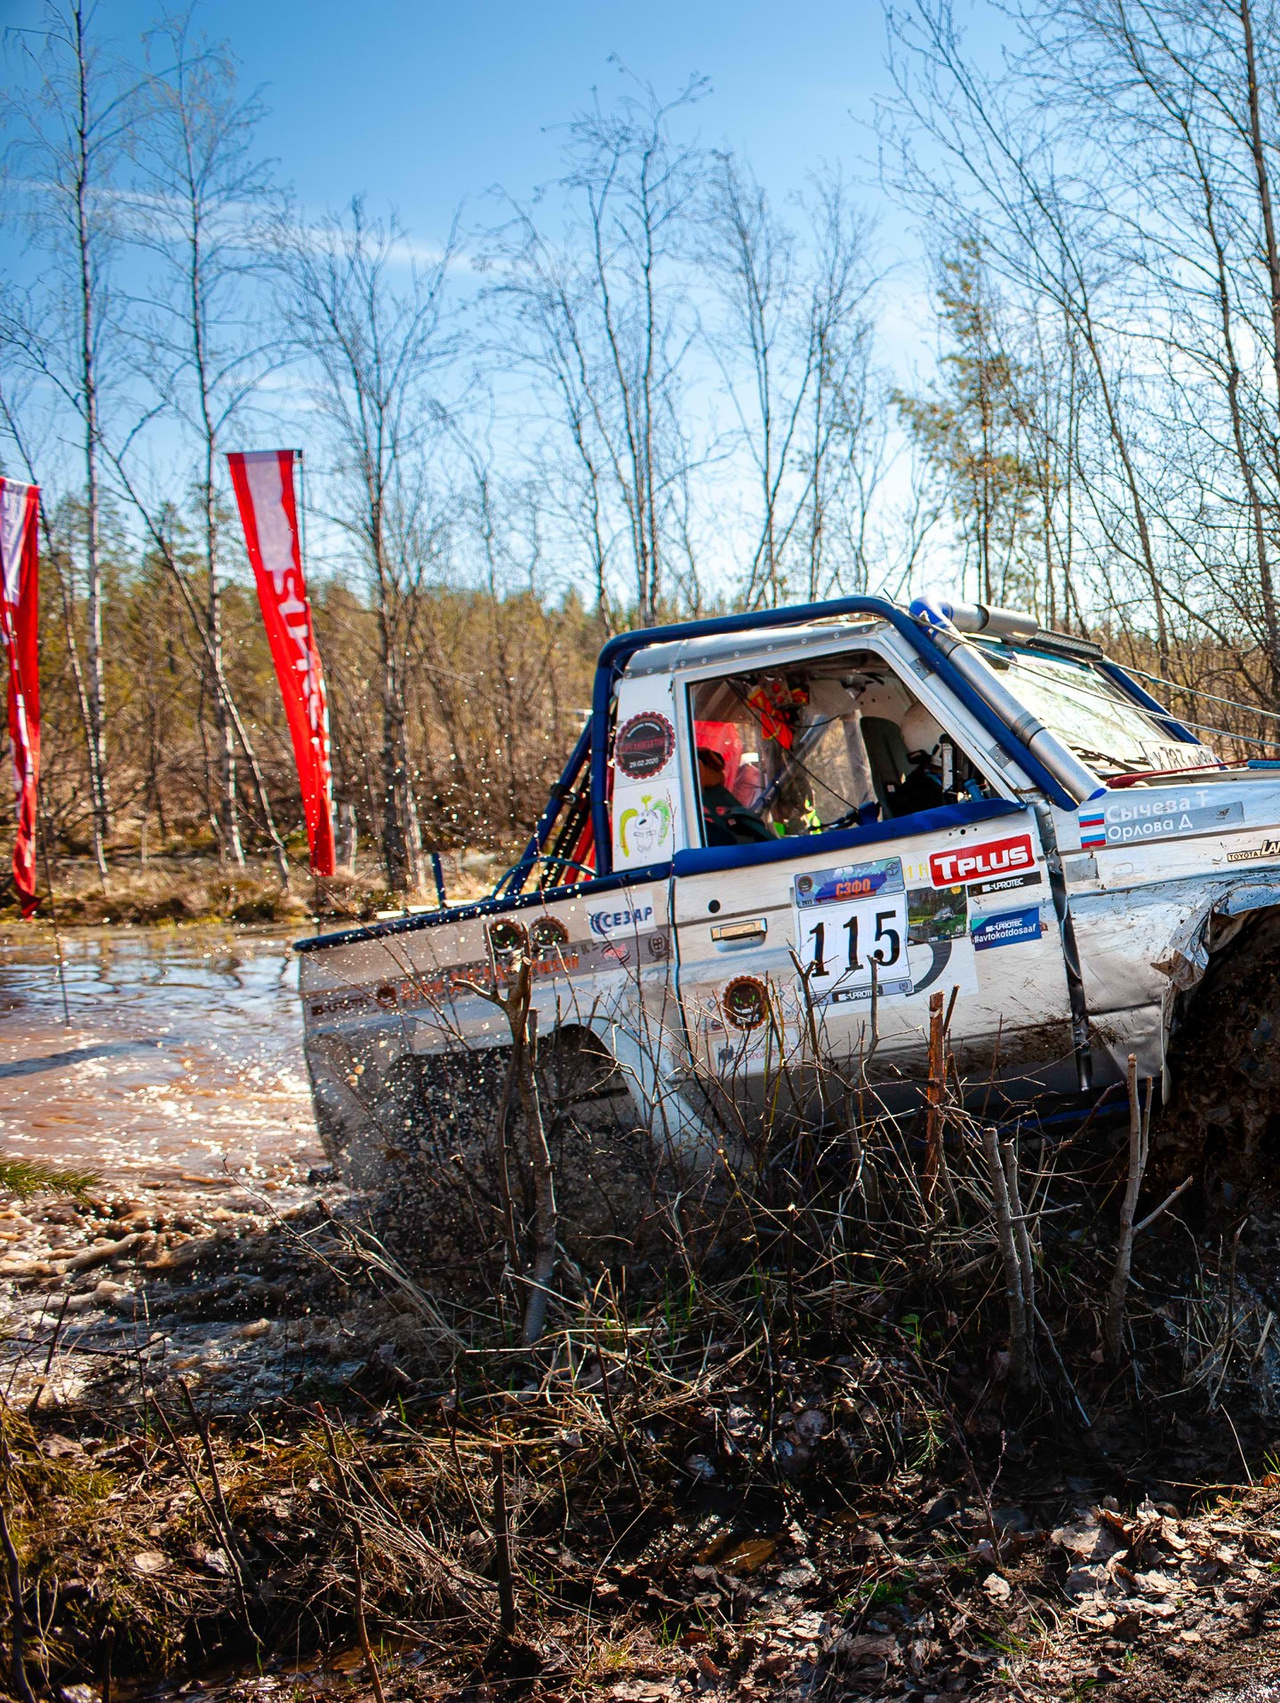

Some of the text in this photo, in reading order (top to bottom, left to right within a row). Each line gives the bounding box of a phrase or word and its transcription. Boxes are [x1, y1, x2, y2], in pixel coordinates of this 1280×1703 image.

[1105, 789, 1209, 822] Сычева Т
[1108, 813, 1193, 841] Орлова Д
[933, 845, 1029, 880] TPLUS
[1229, 850, 1260, 860] TOYOTA
[988, 877, 1024, 891] SUPROTEC
[602, 906, 652, 928] СЕЗАР
[992, 918, 1023, 931] SUPROTEC
[809, 910, 900, 978] 115
[973, 923, 1037, 944] #avtokotdosaaf
